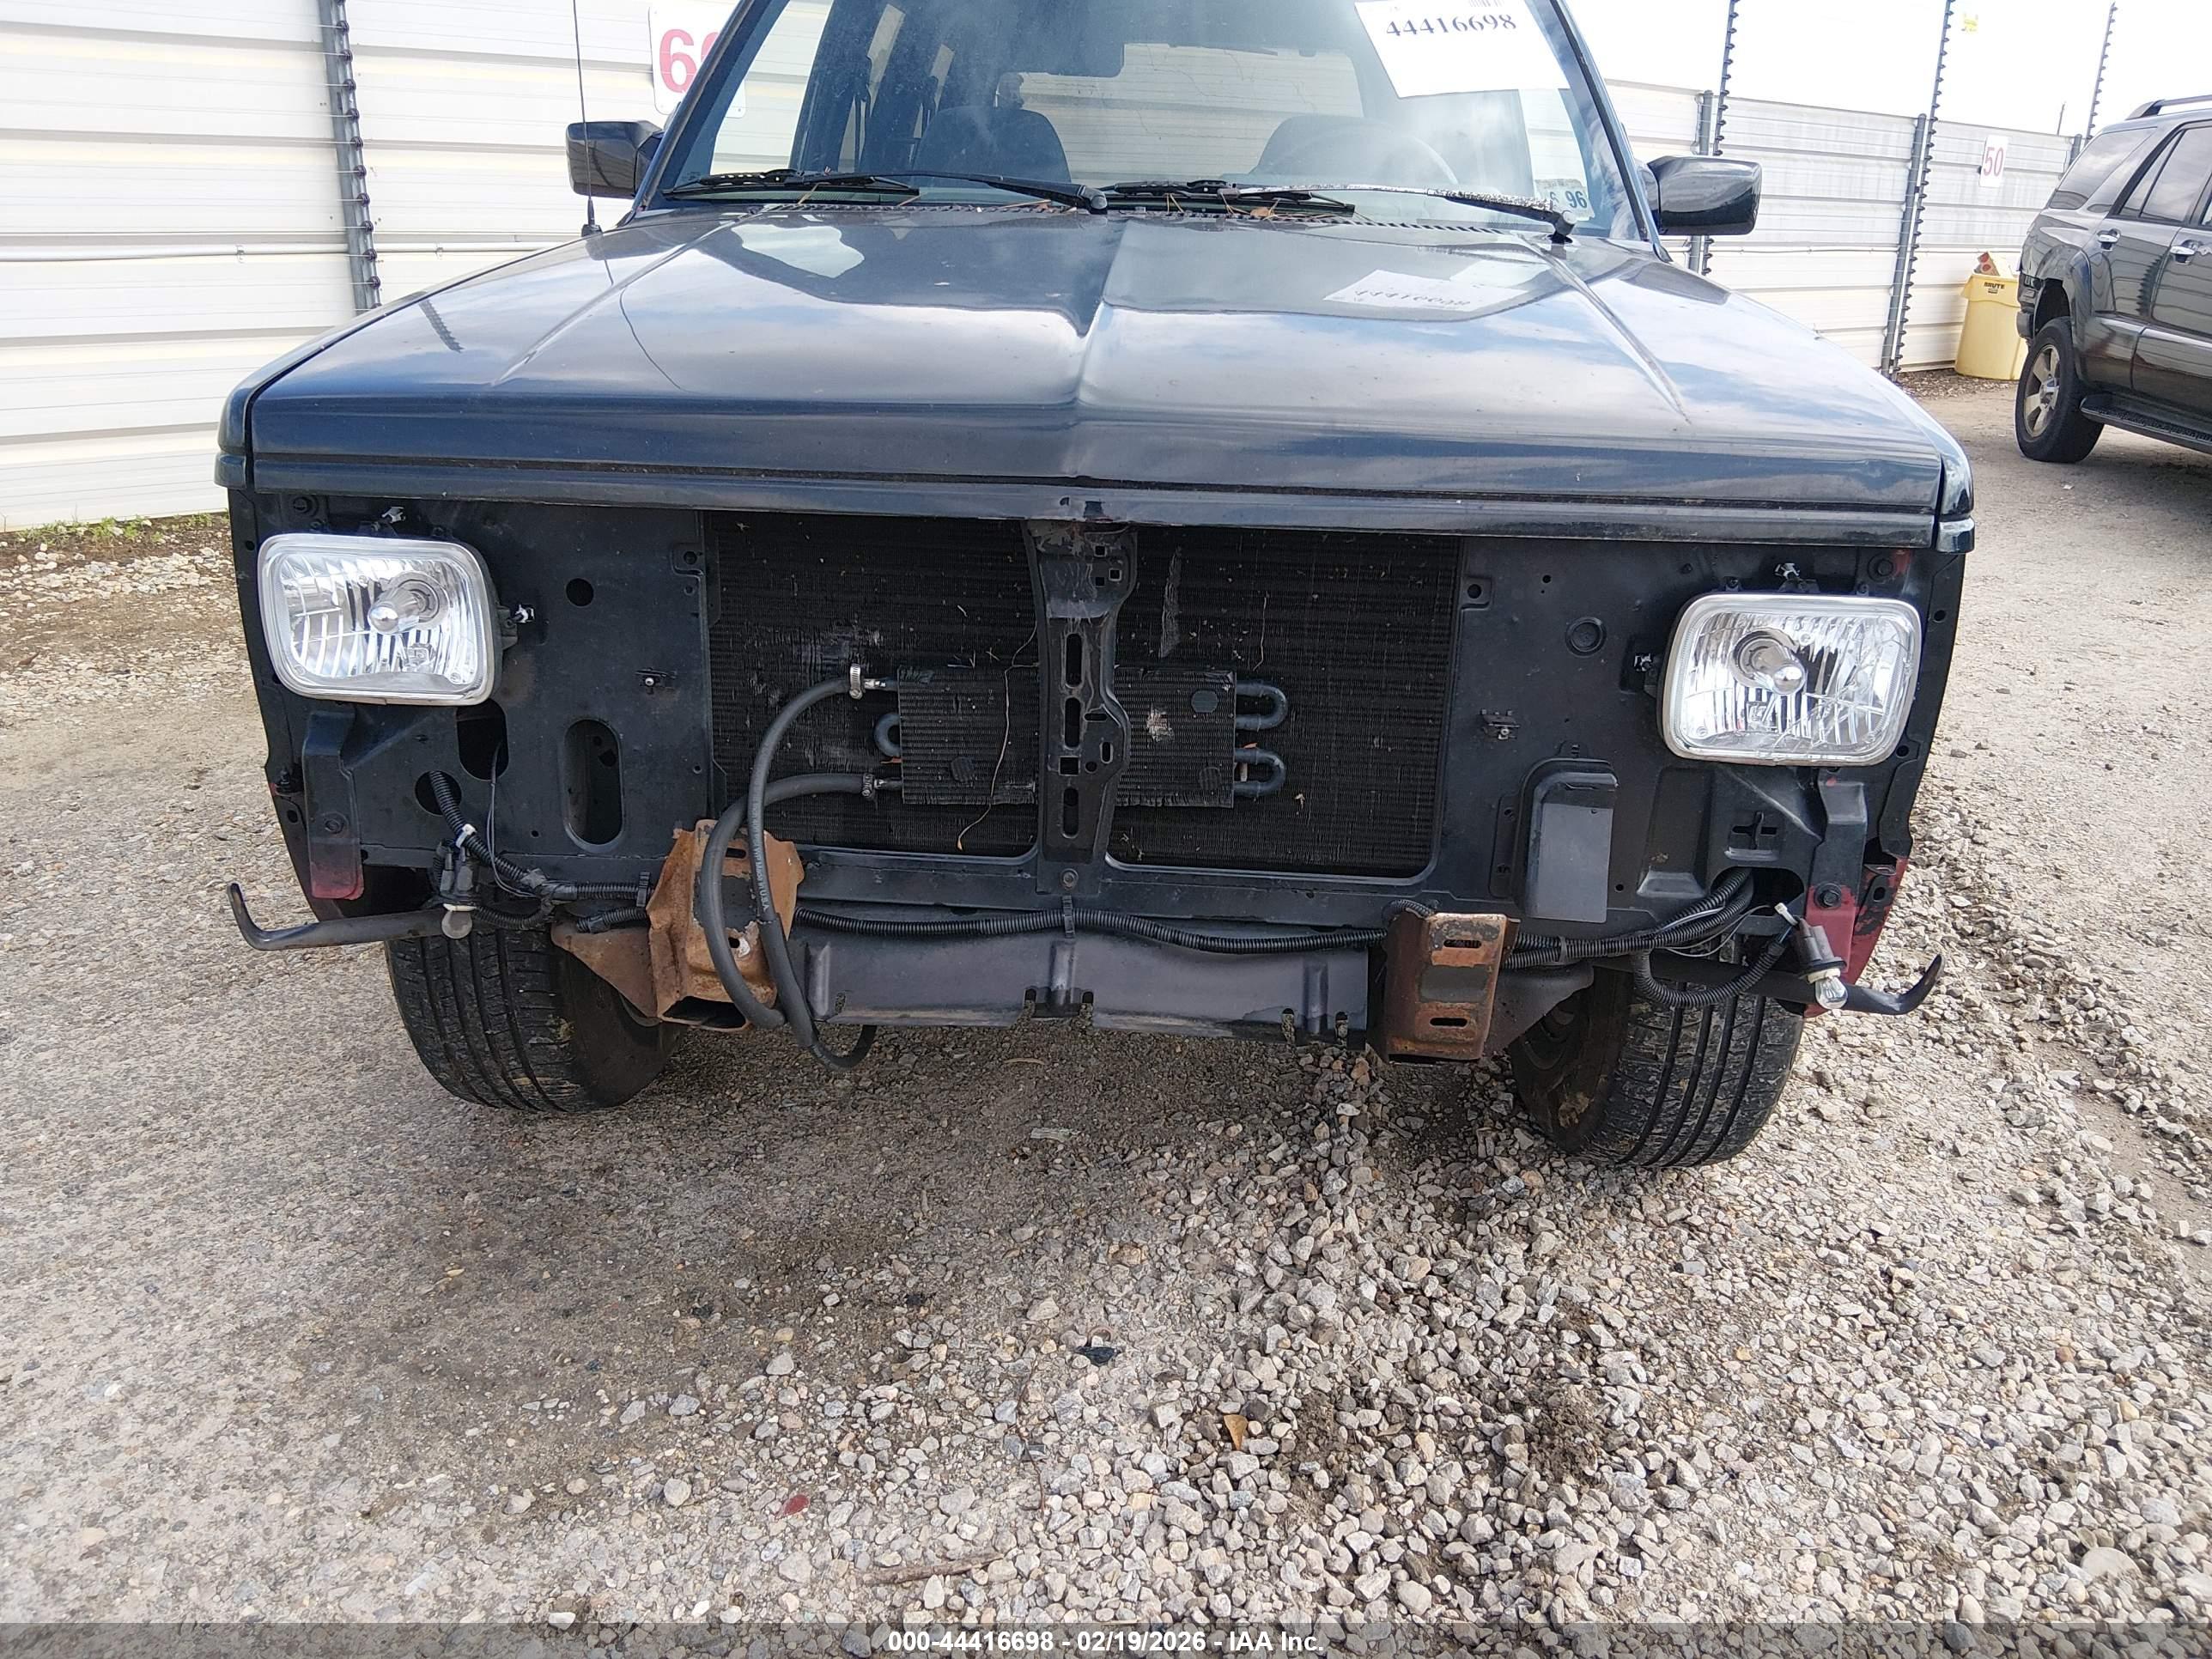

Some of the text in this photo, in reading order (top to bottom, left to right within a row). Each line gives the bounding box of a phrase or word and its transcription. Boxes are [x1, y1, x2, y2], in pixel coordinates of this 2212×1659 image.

[1386, 14, 1516, 36] 44416698
[1984, 146, 2004, 177] 50
[1565, 191, 1588, 208] 96
